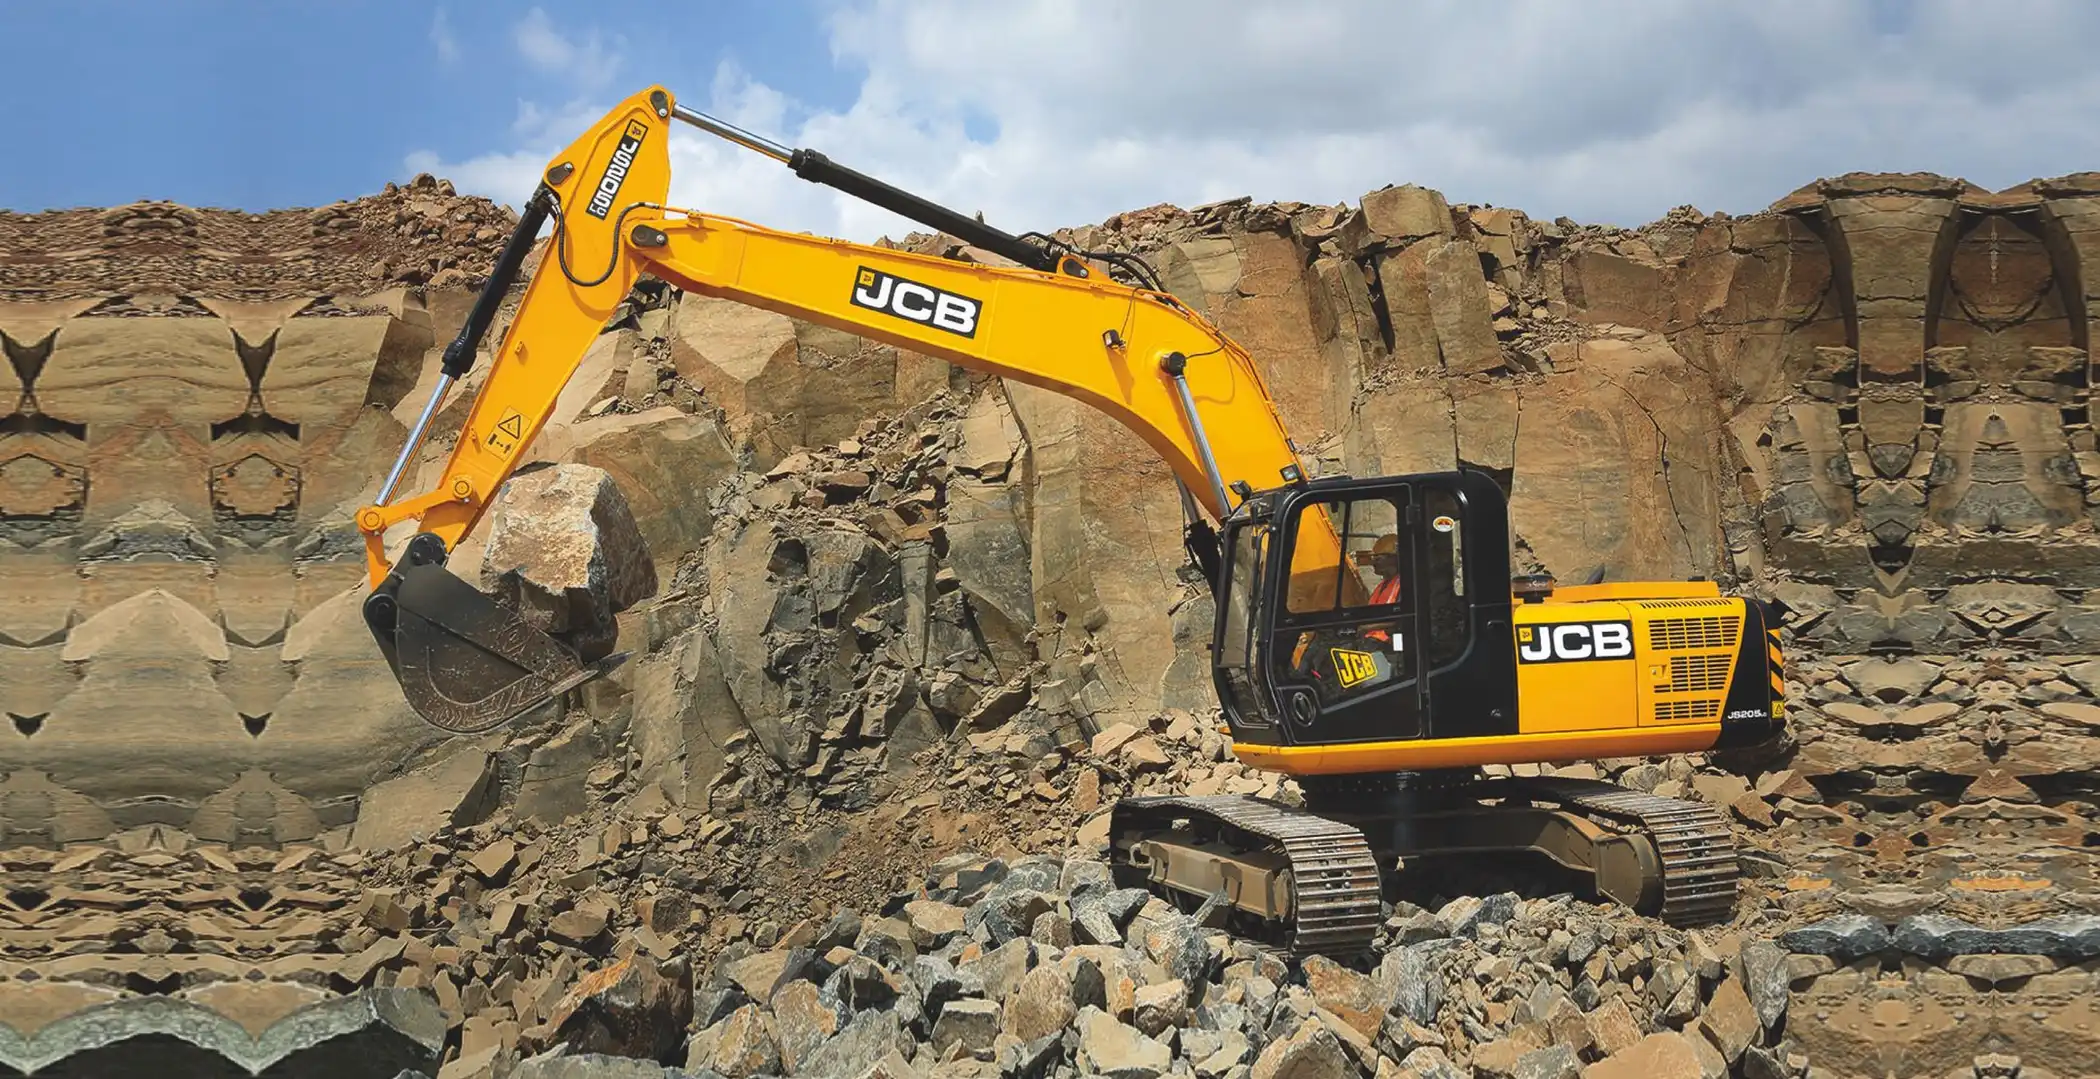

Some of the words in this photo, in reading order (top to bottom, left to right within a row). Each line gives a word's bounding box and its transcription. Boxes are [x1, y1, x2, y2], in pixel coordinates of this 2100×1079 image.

[856, 276, 977, 334] JCB
[1520, 623, 1632, 661] JCB
[1339, 652, 1375, 684] JCB
